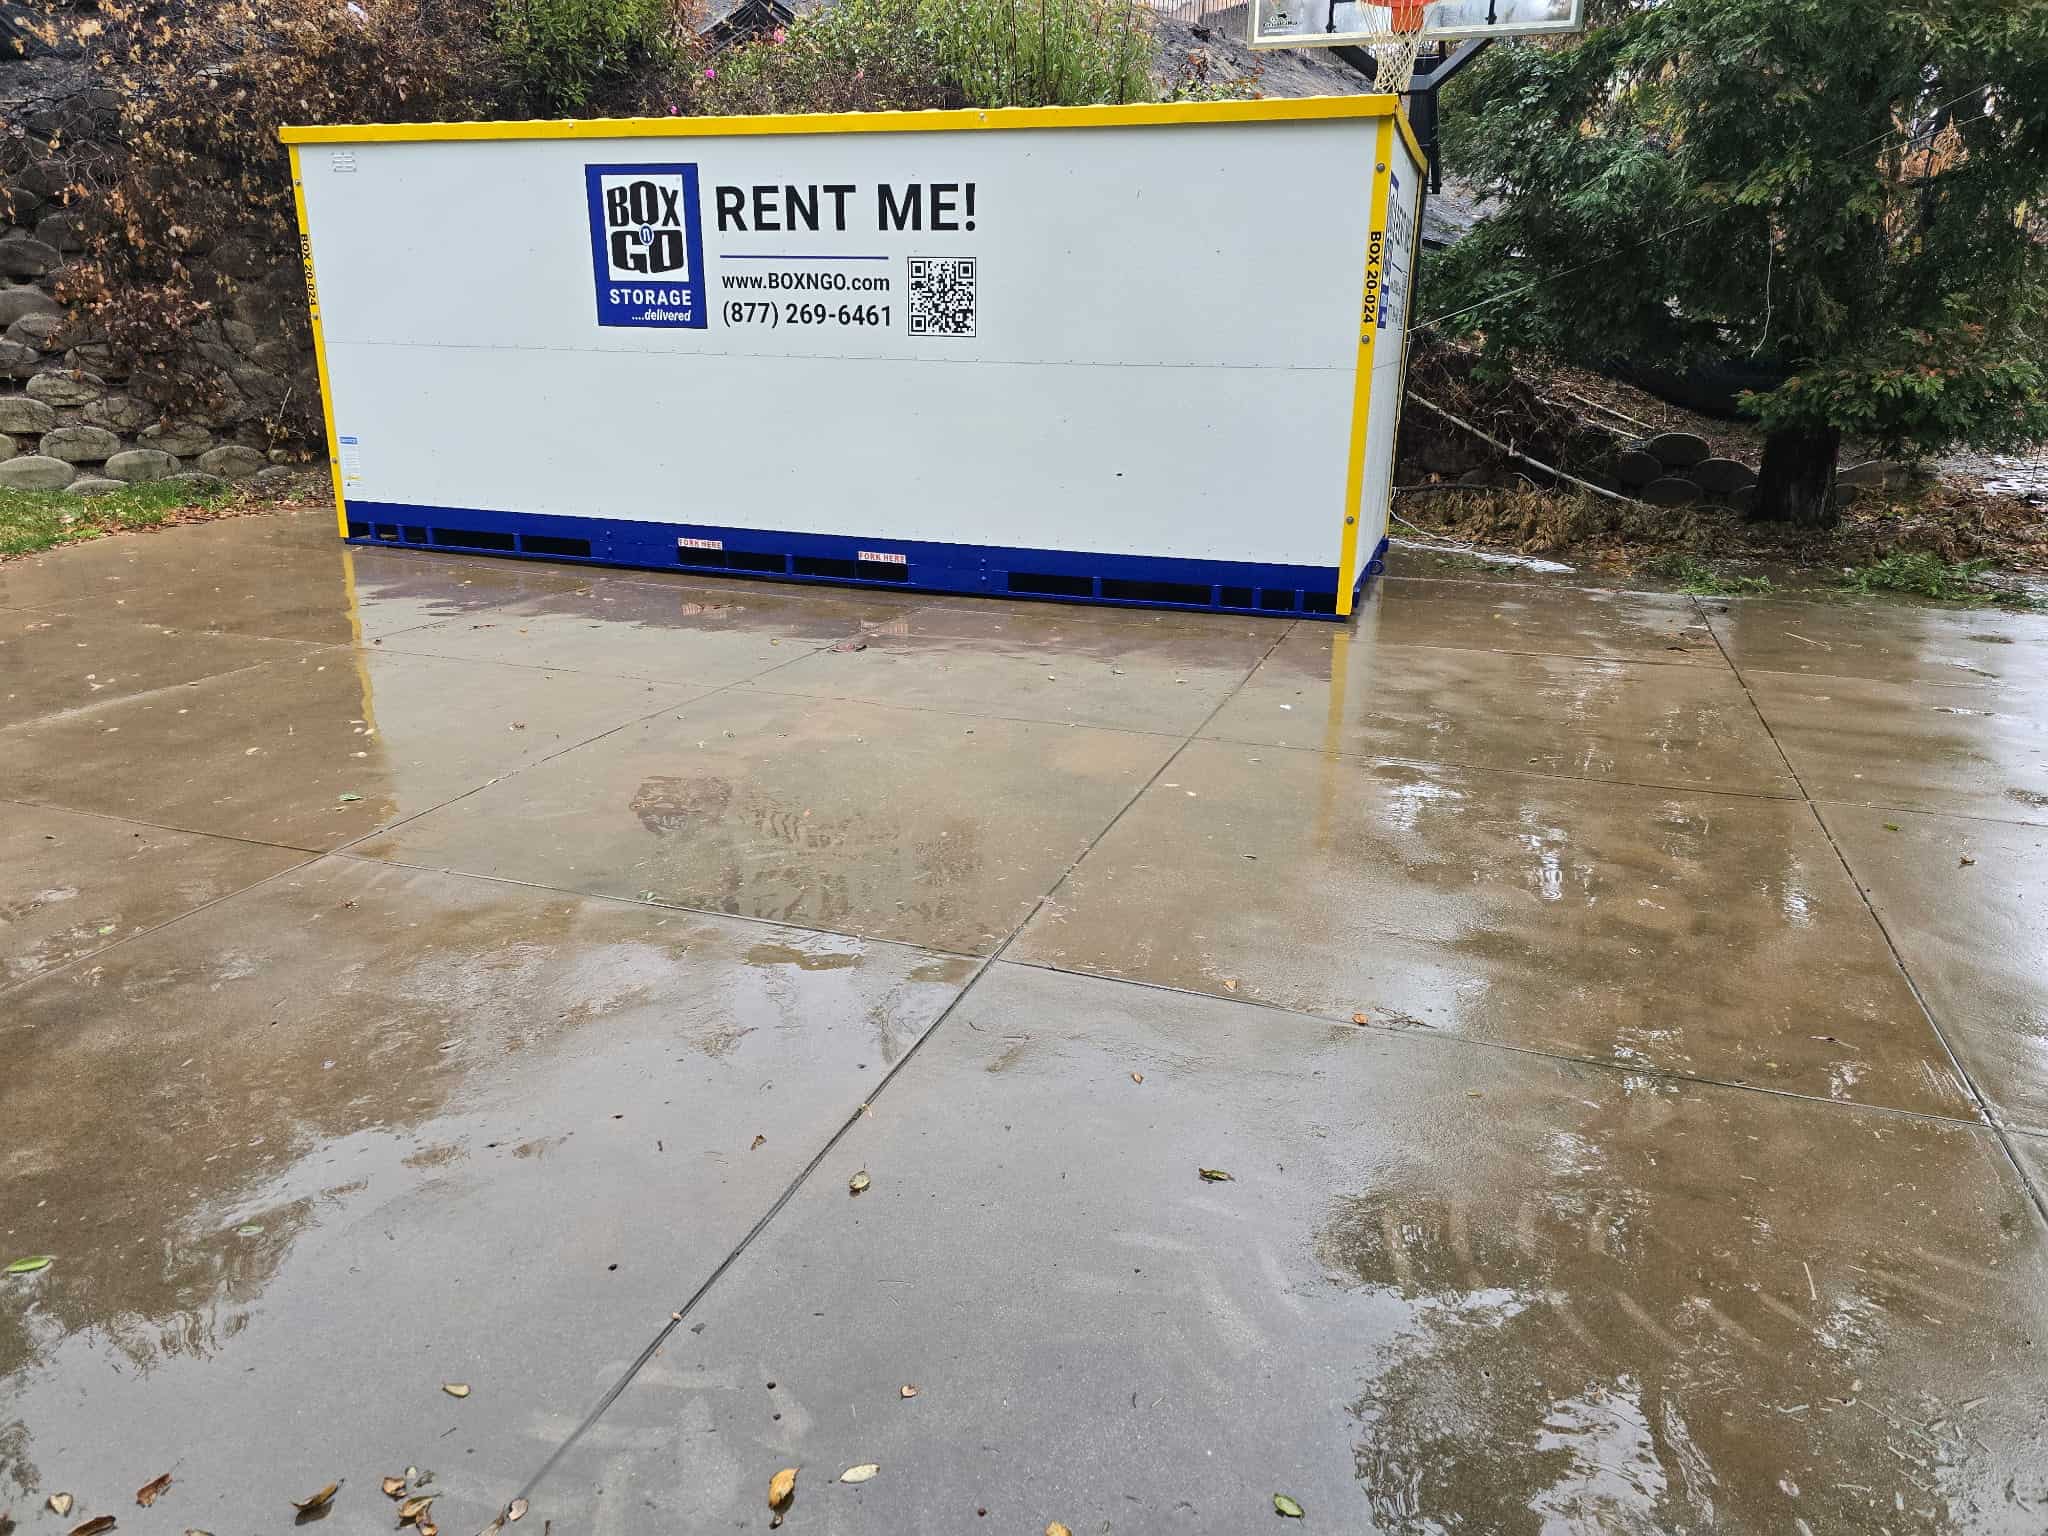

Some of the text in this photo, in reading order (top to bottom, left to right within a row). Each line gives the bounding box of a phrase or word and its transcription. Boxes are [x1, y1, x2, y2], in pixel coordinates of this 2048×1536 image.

[606, 180, 681, 227] BOX
[716, 183, 977, 232] RENT ME!
[611, 230, 685, 274] GO
[301, 234, 316, 306] BOX 20-024
[722, 272, 890, 291] www.BOXNGO.com
[1363, 231, 1382, 324] BOX 20-024
[610, 289, 692, 306] STORAGE
[723, 301, 891, 328] (877) 269-6461
[680, 539, 721, 549] FORK HERE
[860, 551, 905, 563] FORK HERE
